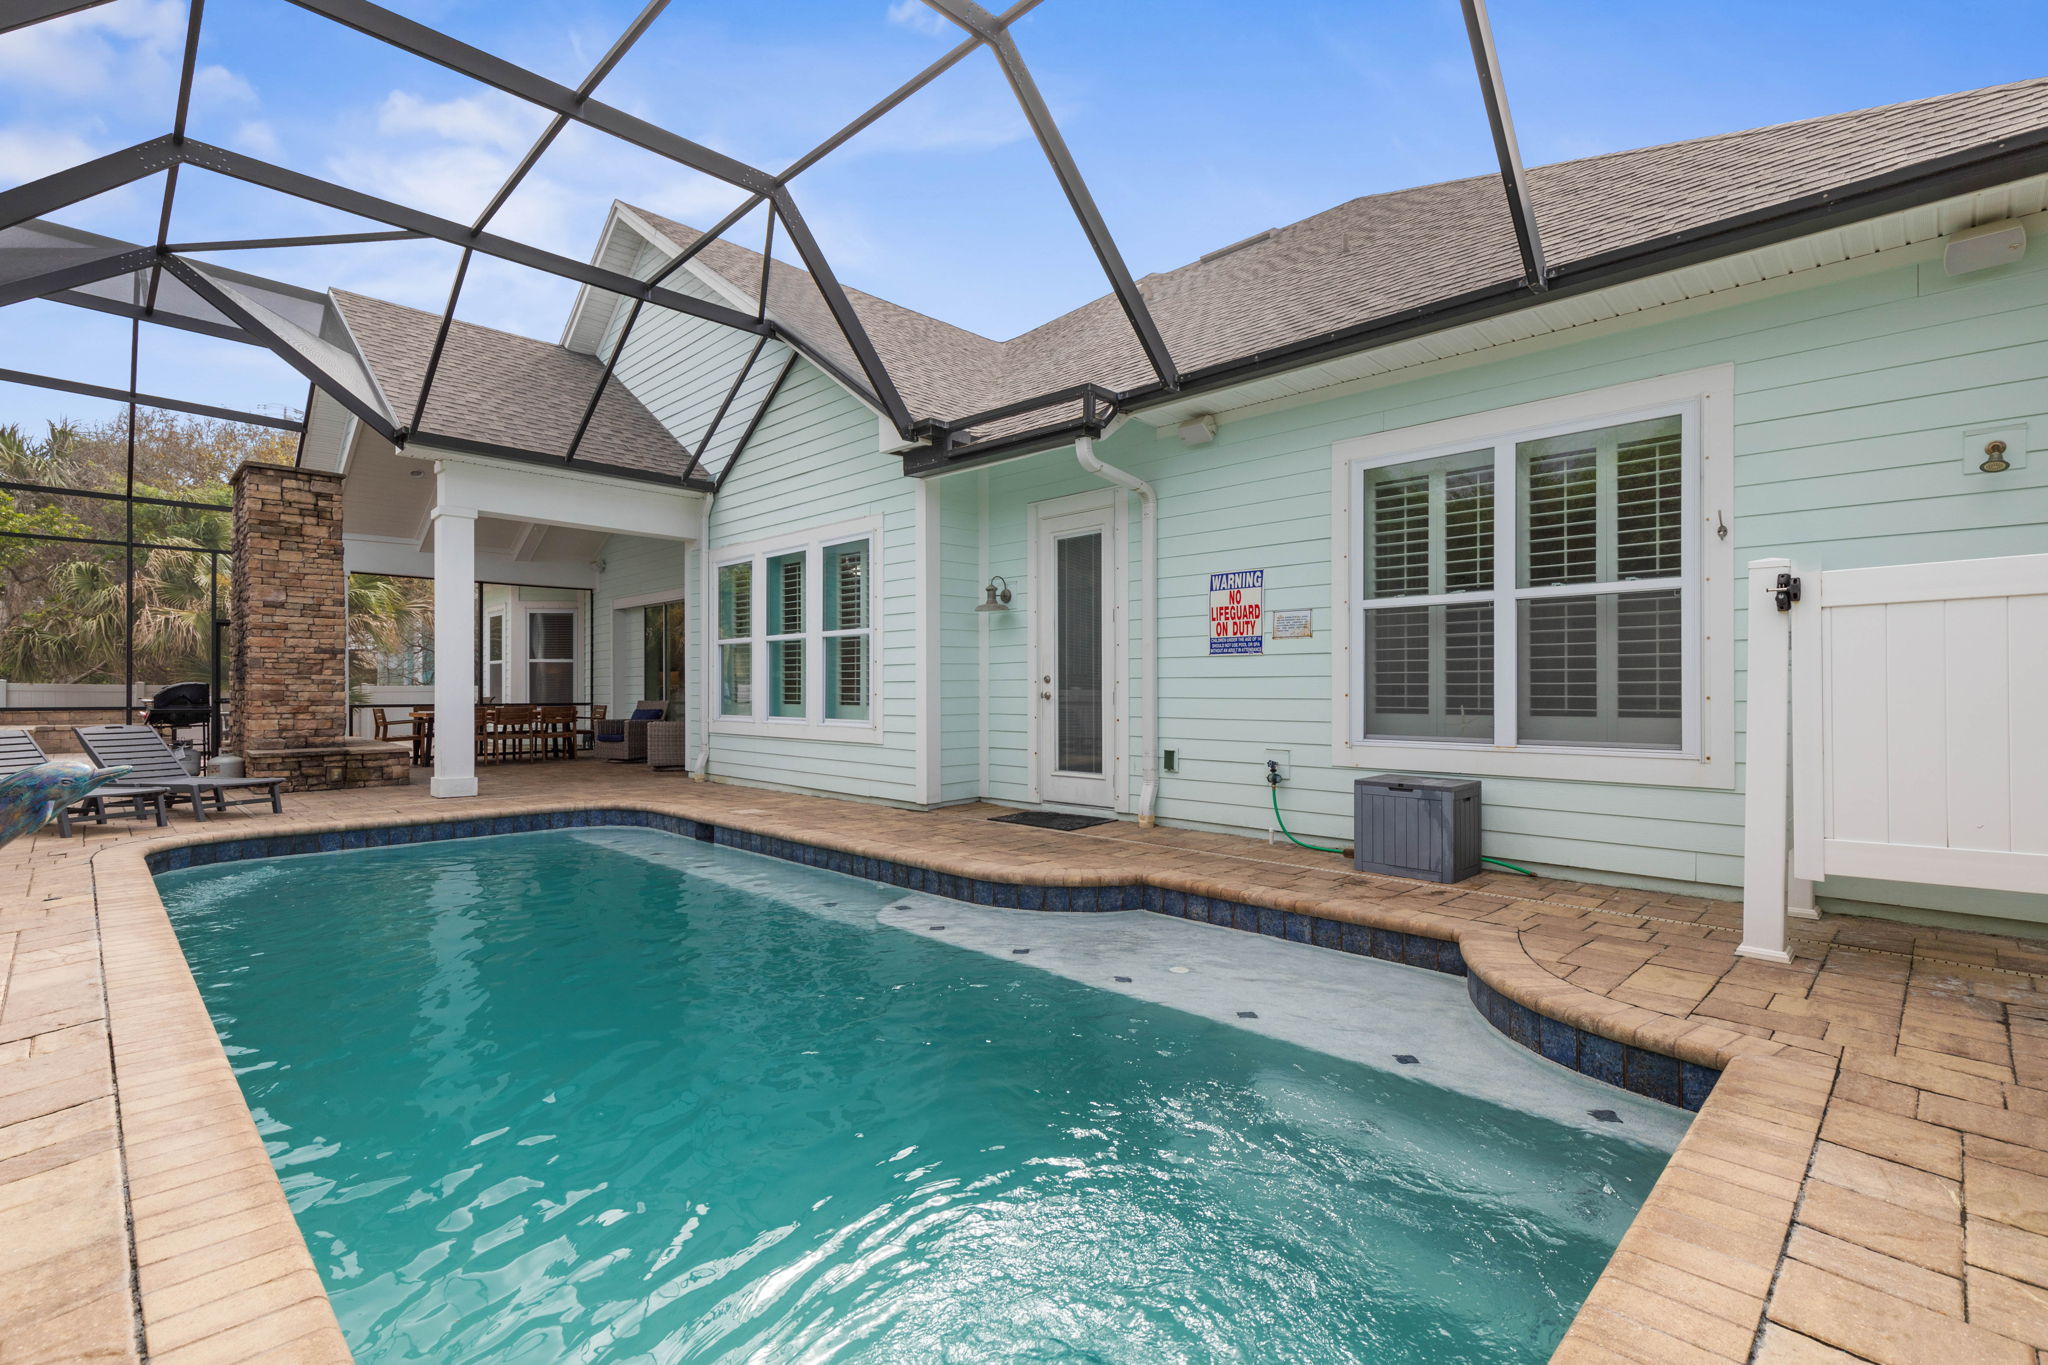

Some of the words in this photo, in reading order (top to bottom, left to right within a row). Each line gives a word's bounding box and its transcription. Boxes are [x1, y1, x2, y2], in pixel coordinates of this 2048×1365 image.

[1212, 572, 1262, 591] WARNING
[1229, 590, 1242, 605] NO
[1211, 604, 1261, 621] LIFEGUARD
[1216, 621, 1228, 637] ON
[1232, 620, 1256, 636] DUTY
